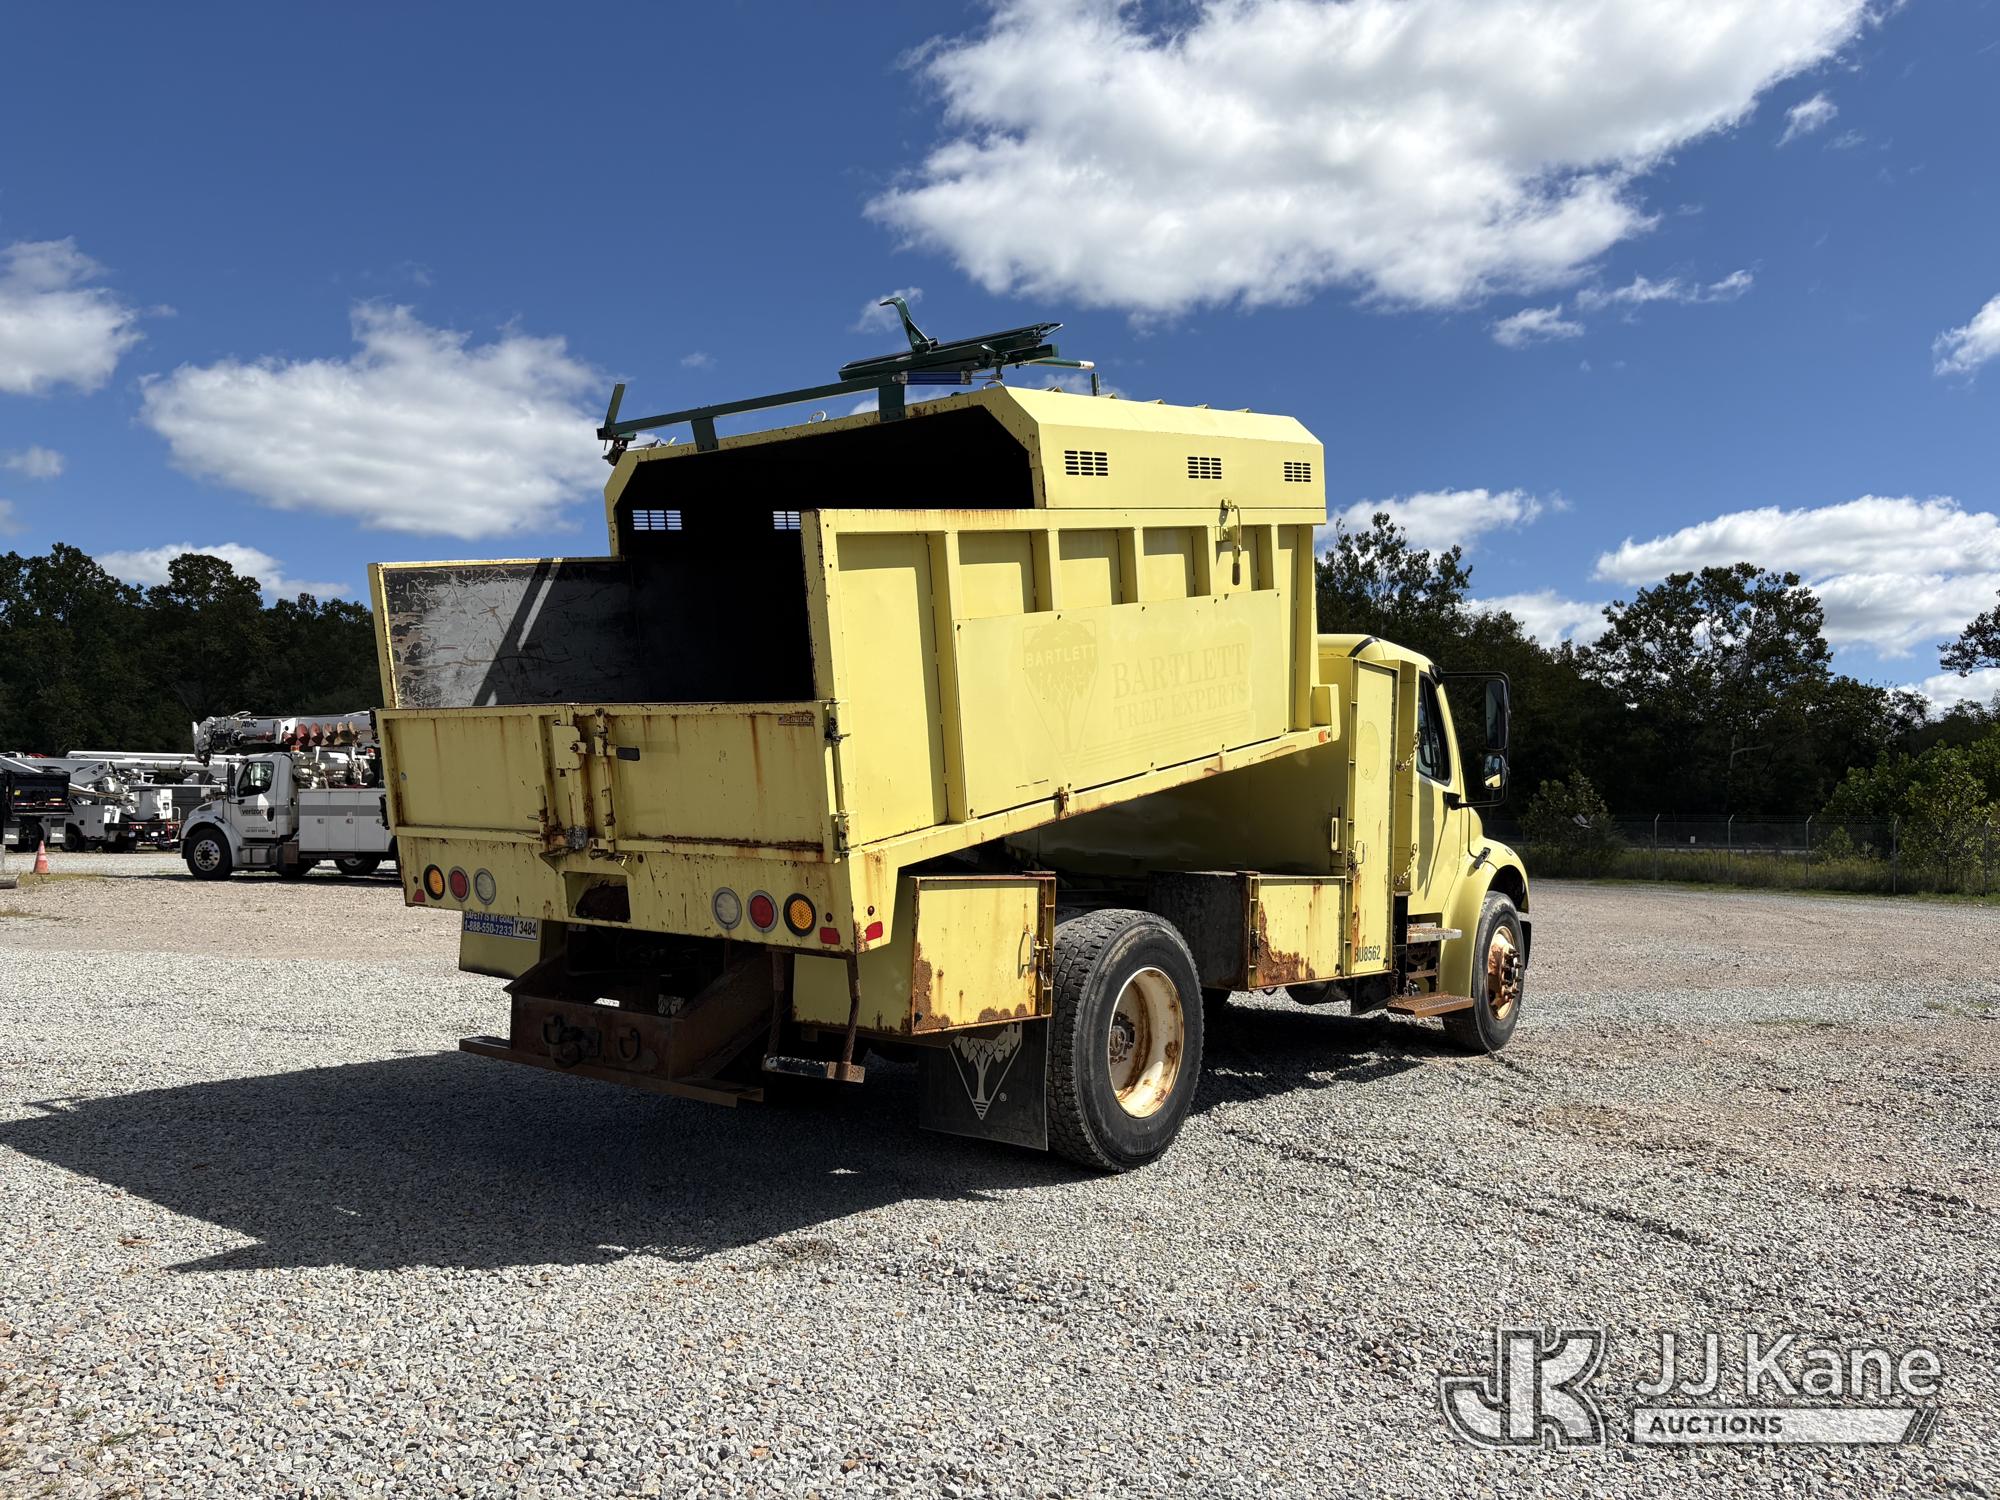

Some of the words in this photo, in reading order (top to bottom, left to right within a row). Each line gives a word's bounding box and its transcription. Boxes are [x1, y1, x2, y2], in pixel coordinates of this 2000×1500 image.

[1025, 644, 1096, 668] BARTLETT
[1112, 643, 1246, 699] BARTLETT
[1113, 697, 1166, 731] TREE
[1173, 679, 1248, 719] EXPERTS
[241, 808, 264, 816] verizon
[464, 919, 513, 936] 1-888-550-7233
